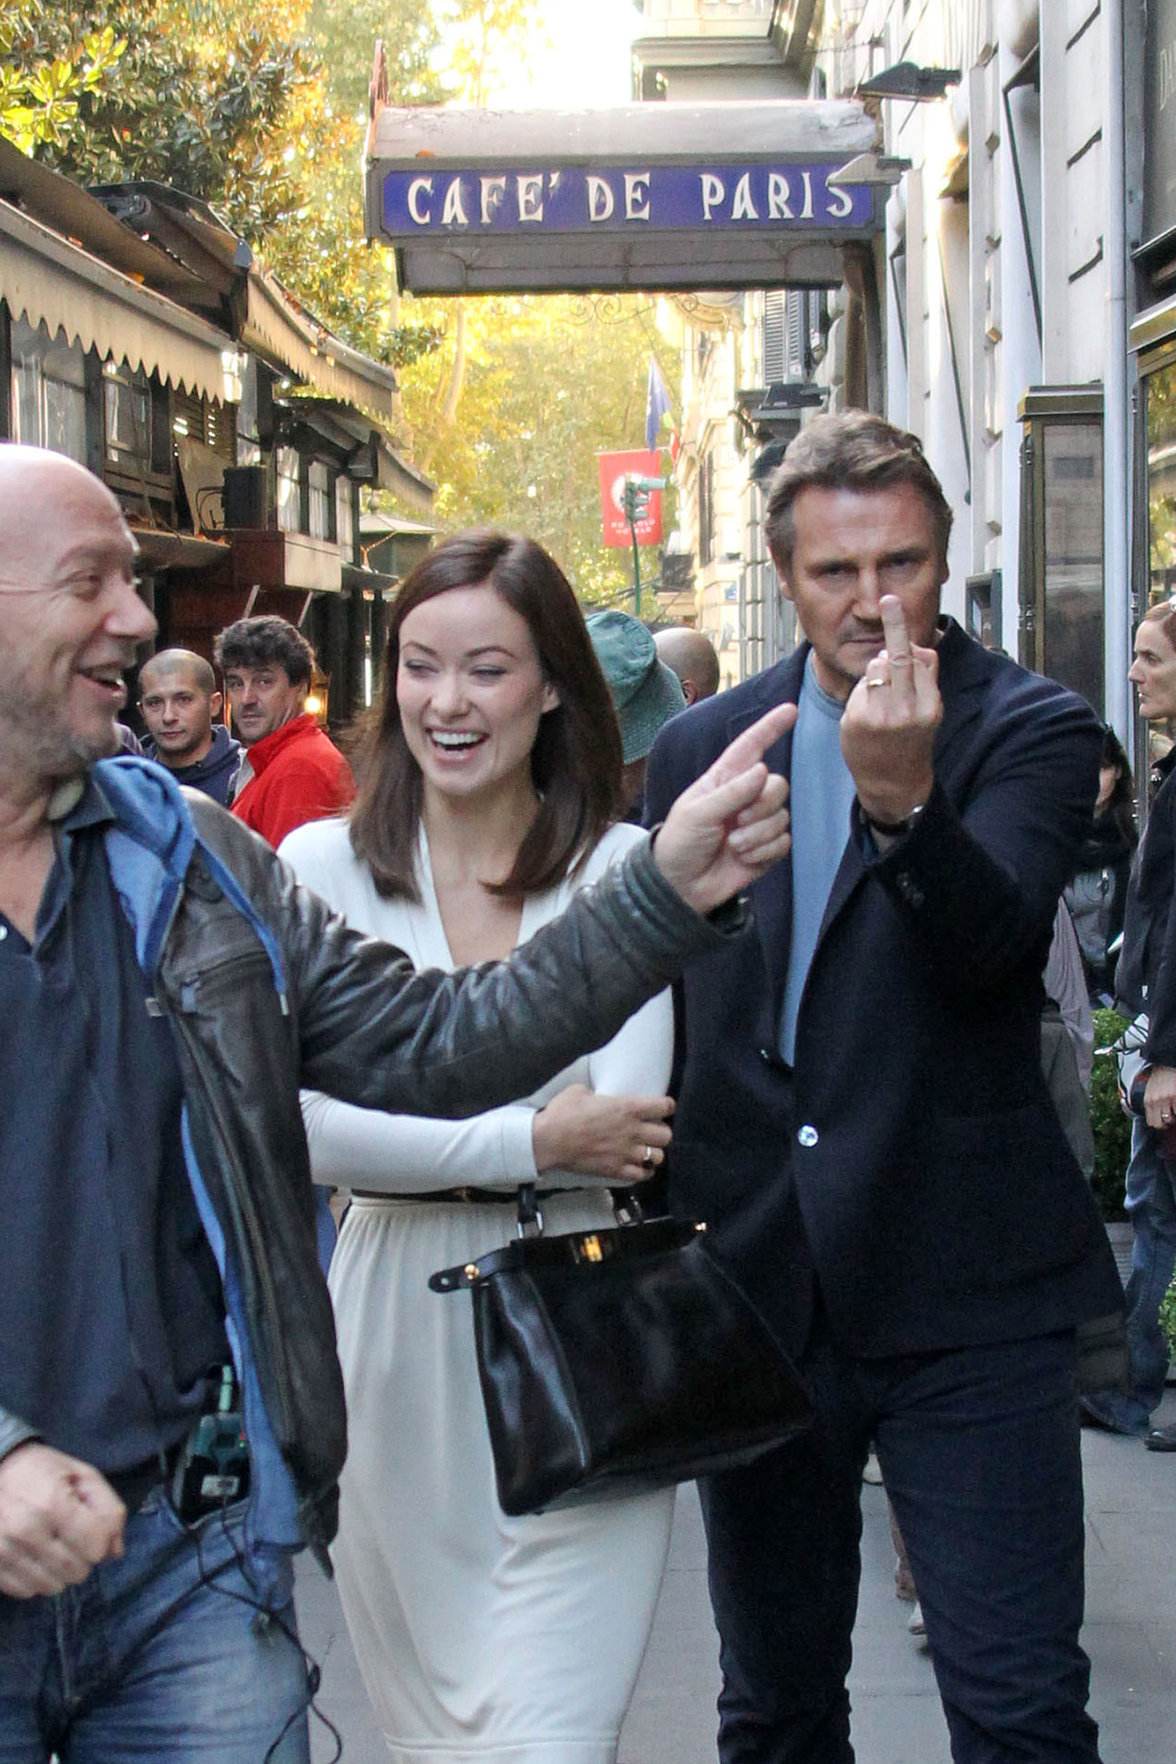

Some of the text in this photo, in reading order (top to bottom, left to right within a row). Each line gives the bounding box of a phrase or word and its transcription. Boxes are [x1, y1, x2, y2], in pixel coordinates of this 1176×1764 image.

[407, 170, 853, 225] CAFE' DE PARIS
